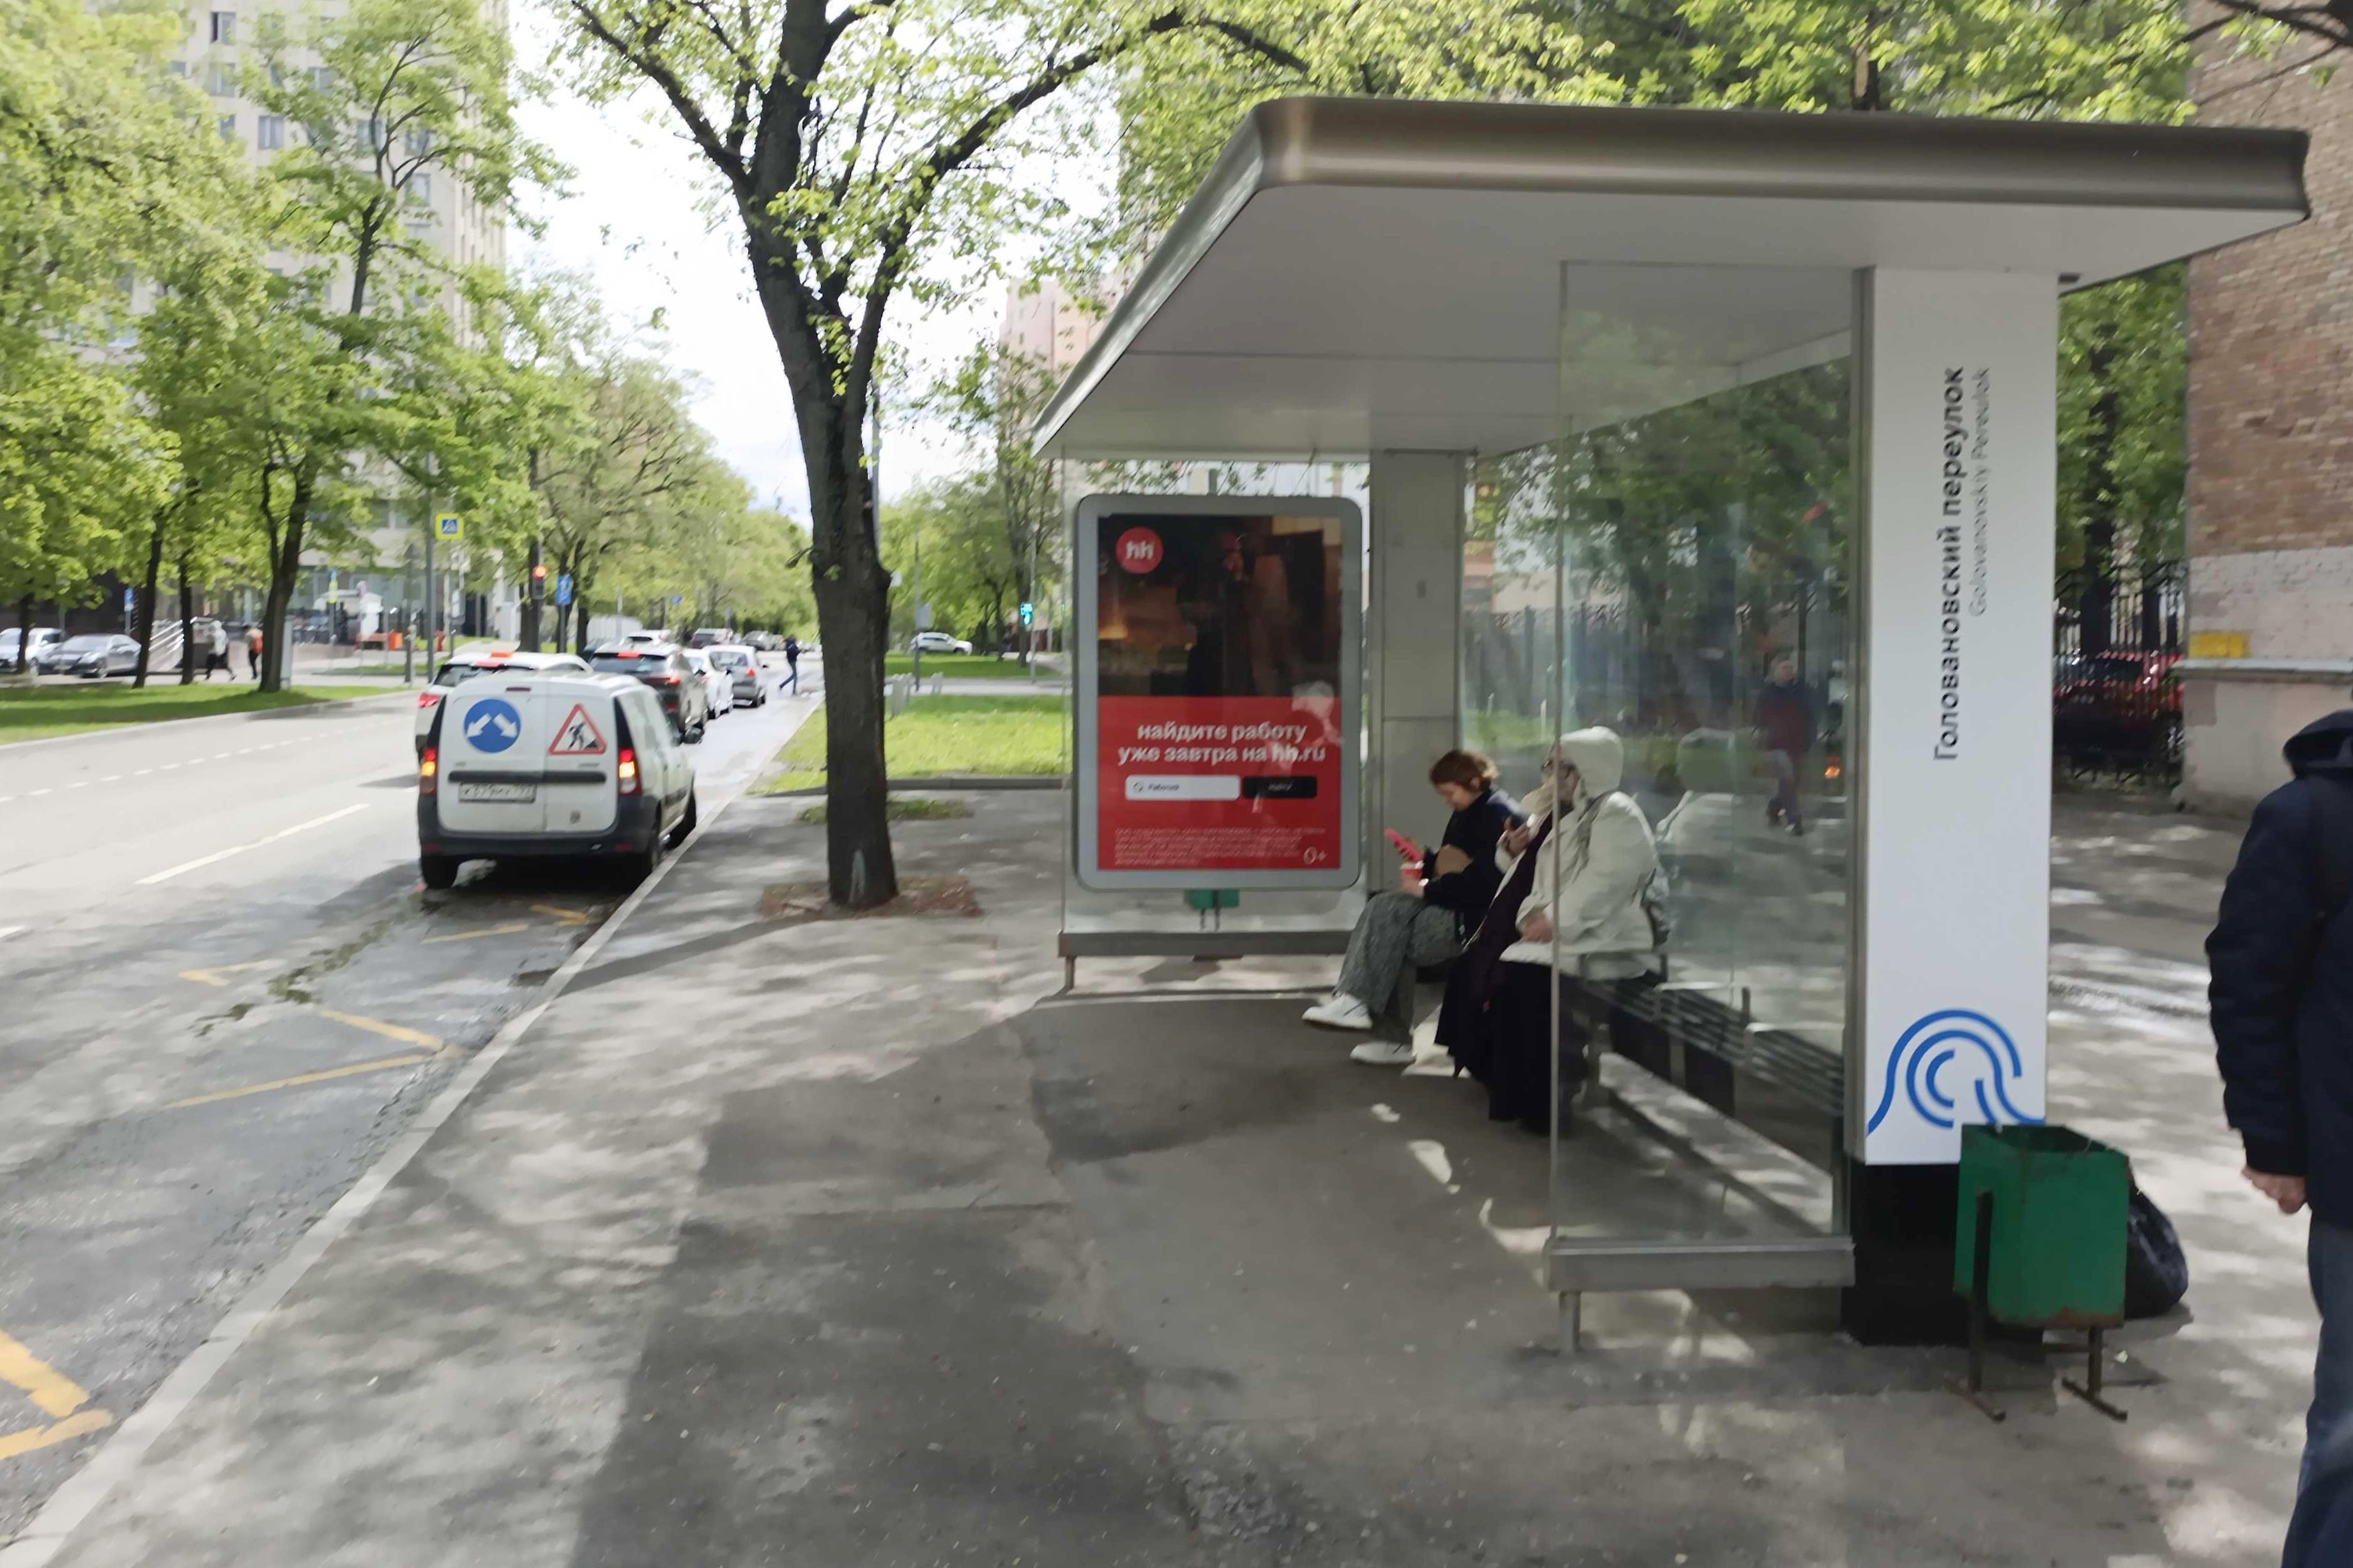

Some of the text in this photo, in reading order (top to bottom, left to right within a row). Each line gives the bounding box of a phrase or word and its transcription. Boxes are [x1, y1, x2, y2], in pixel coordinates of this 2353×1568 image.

[1126, 540, 1154, 560] hh
[1933, 366, 1968, 761] Головановский переулок
[1137, 721, 1307, 743] найдите работу
[1118, 742, 1326, 766] уже завтра на hh.ru
